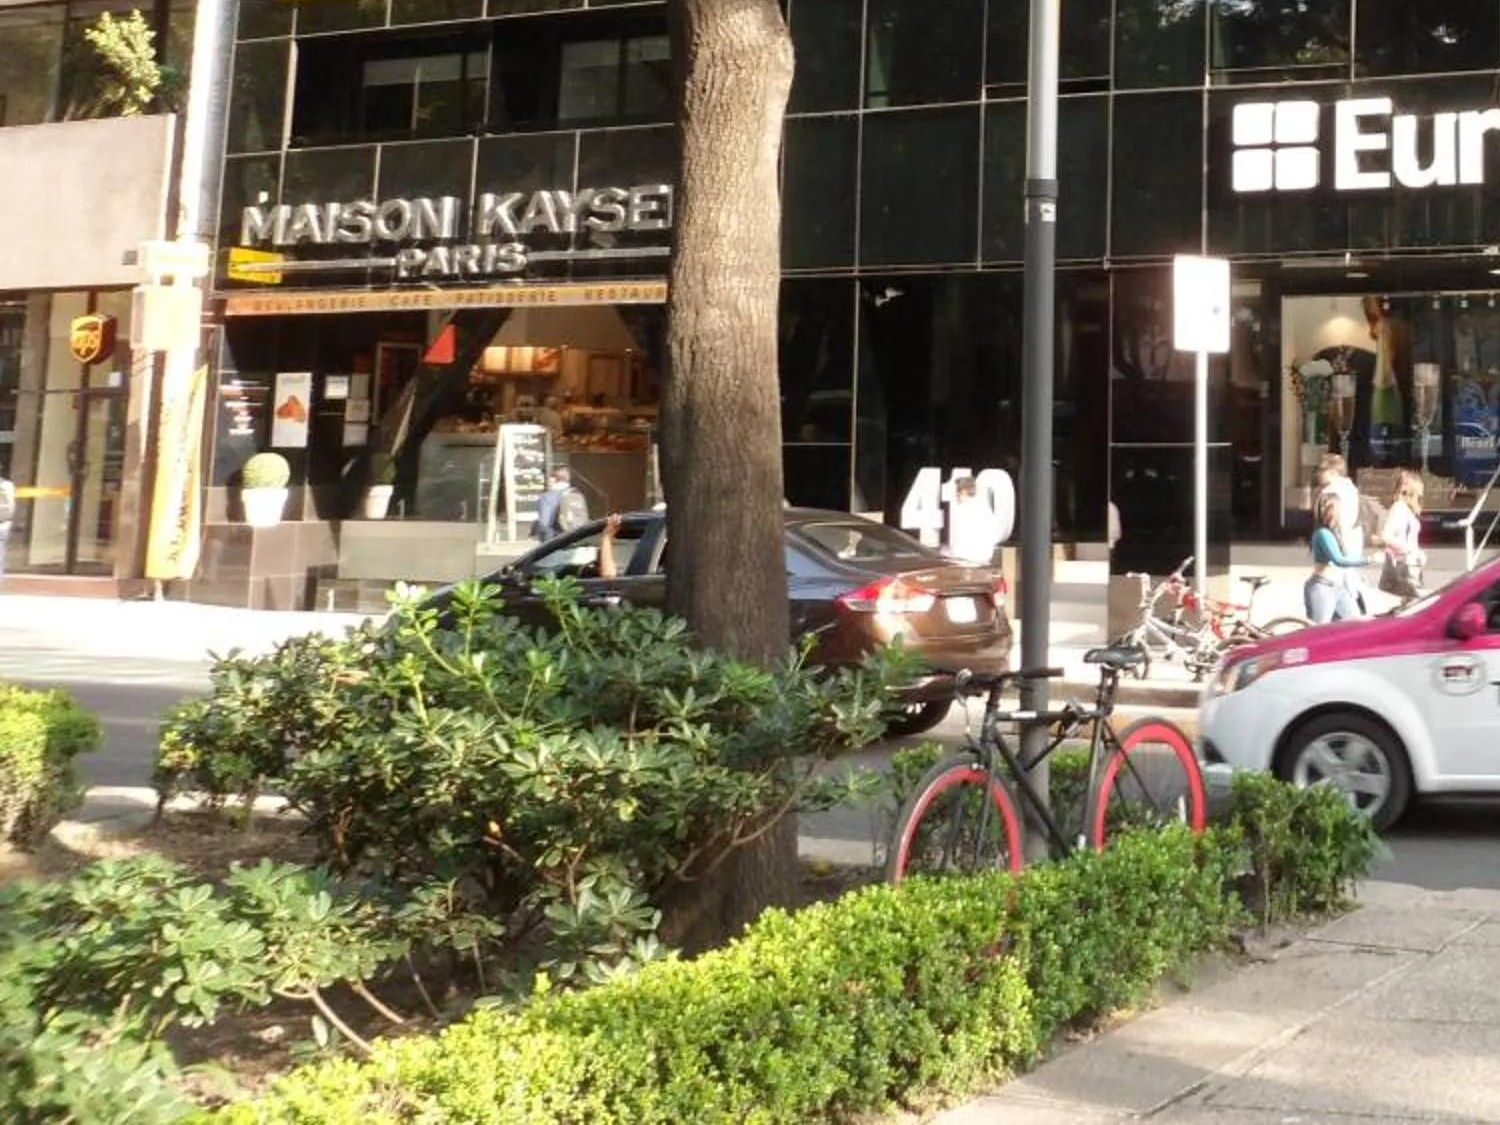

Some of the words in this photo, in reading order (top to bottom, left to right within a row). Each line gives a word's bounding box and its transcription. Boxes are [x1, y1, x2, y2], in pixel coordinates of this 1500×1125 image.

[241, 195, 461, 246] MAISON
[479, 184, 673, 235] KAYSE
[396, 243, 528, 277] PARIS
[900, 466, 1016, 549] 410
